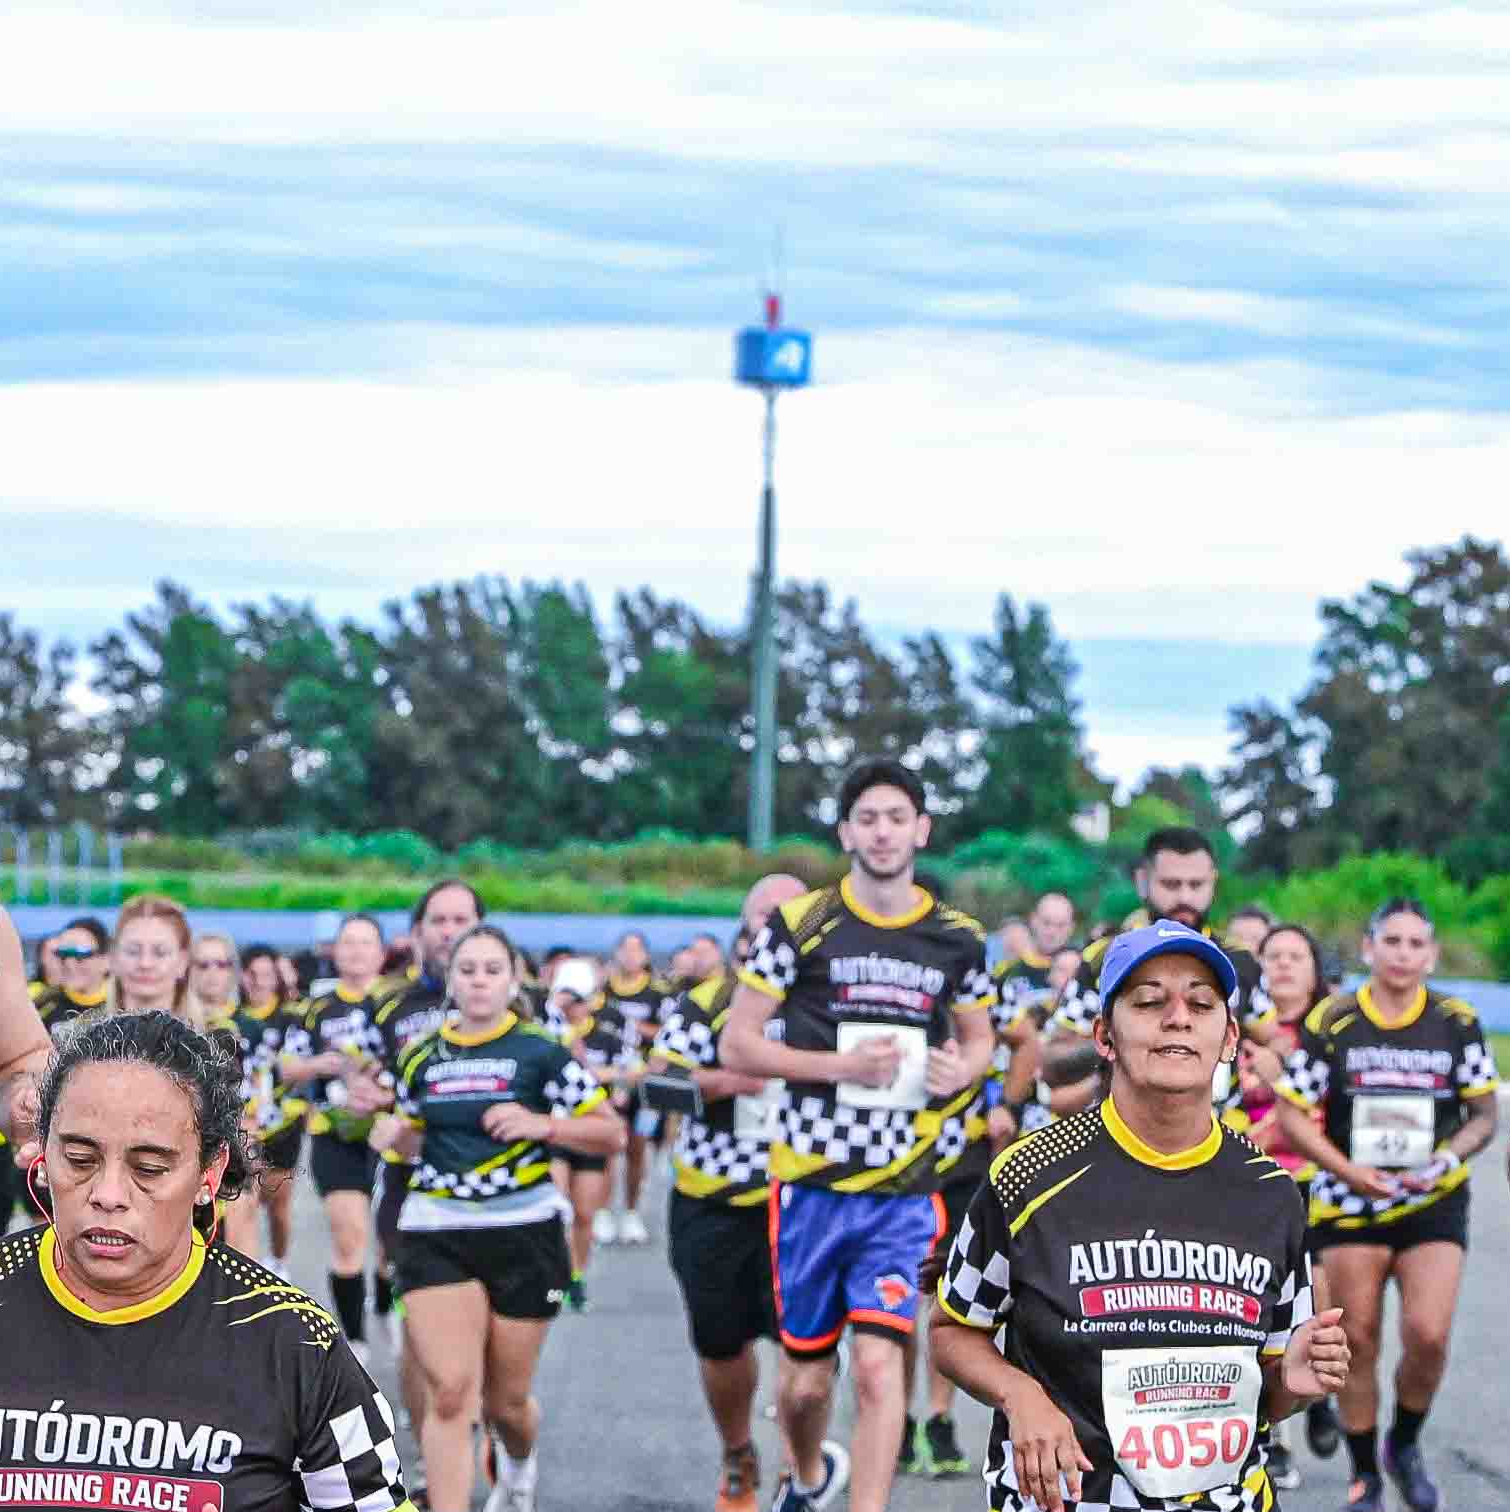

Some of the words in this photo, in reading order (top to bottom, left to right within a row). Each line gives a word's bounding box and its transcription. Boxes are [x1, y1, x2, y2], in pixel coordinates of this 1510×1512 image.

[1069, 1228, 1272, 1296] AUTÓDROMO
[1102, 1285, 1193, 1312] RUNNING
[1199, 1287, 1244, 1318] RACE
[1063, 1319, 1078, 1332] La
[1080, 1318, 1127, 1333] Carrera
[1129, 1318, 1146, 1333] de
[1147, 1318, 1166, 1333] los
[1168, 1319, 1212, 1335] Clubes
[1213, 1321, 1232, 1336] del
[1127, 1356, 1242, 1391] AUTÓDROMO
[1117, 1418, 1249, 1470] 4050
[110, 1477, 190, 1512] RACE
